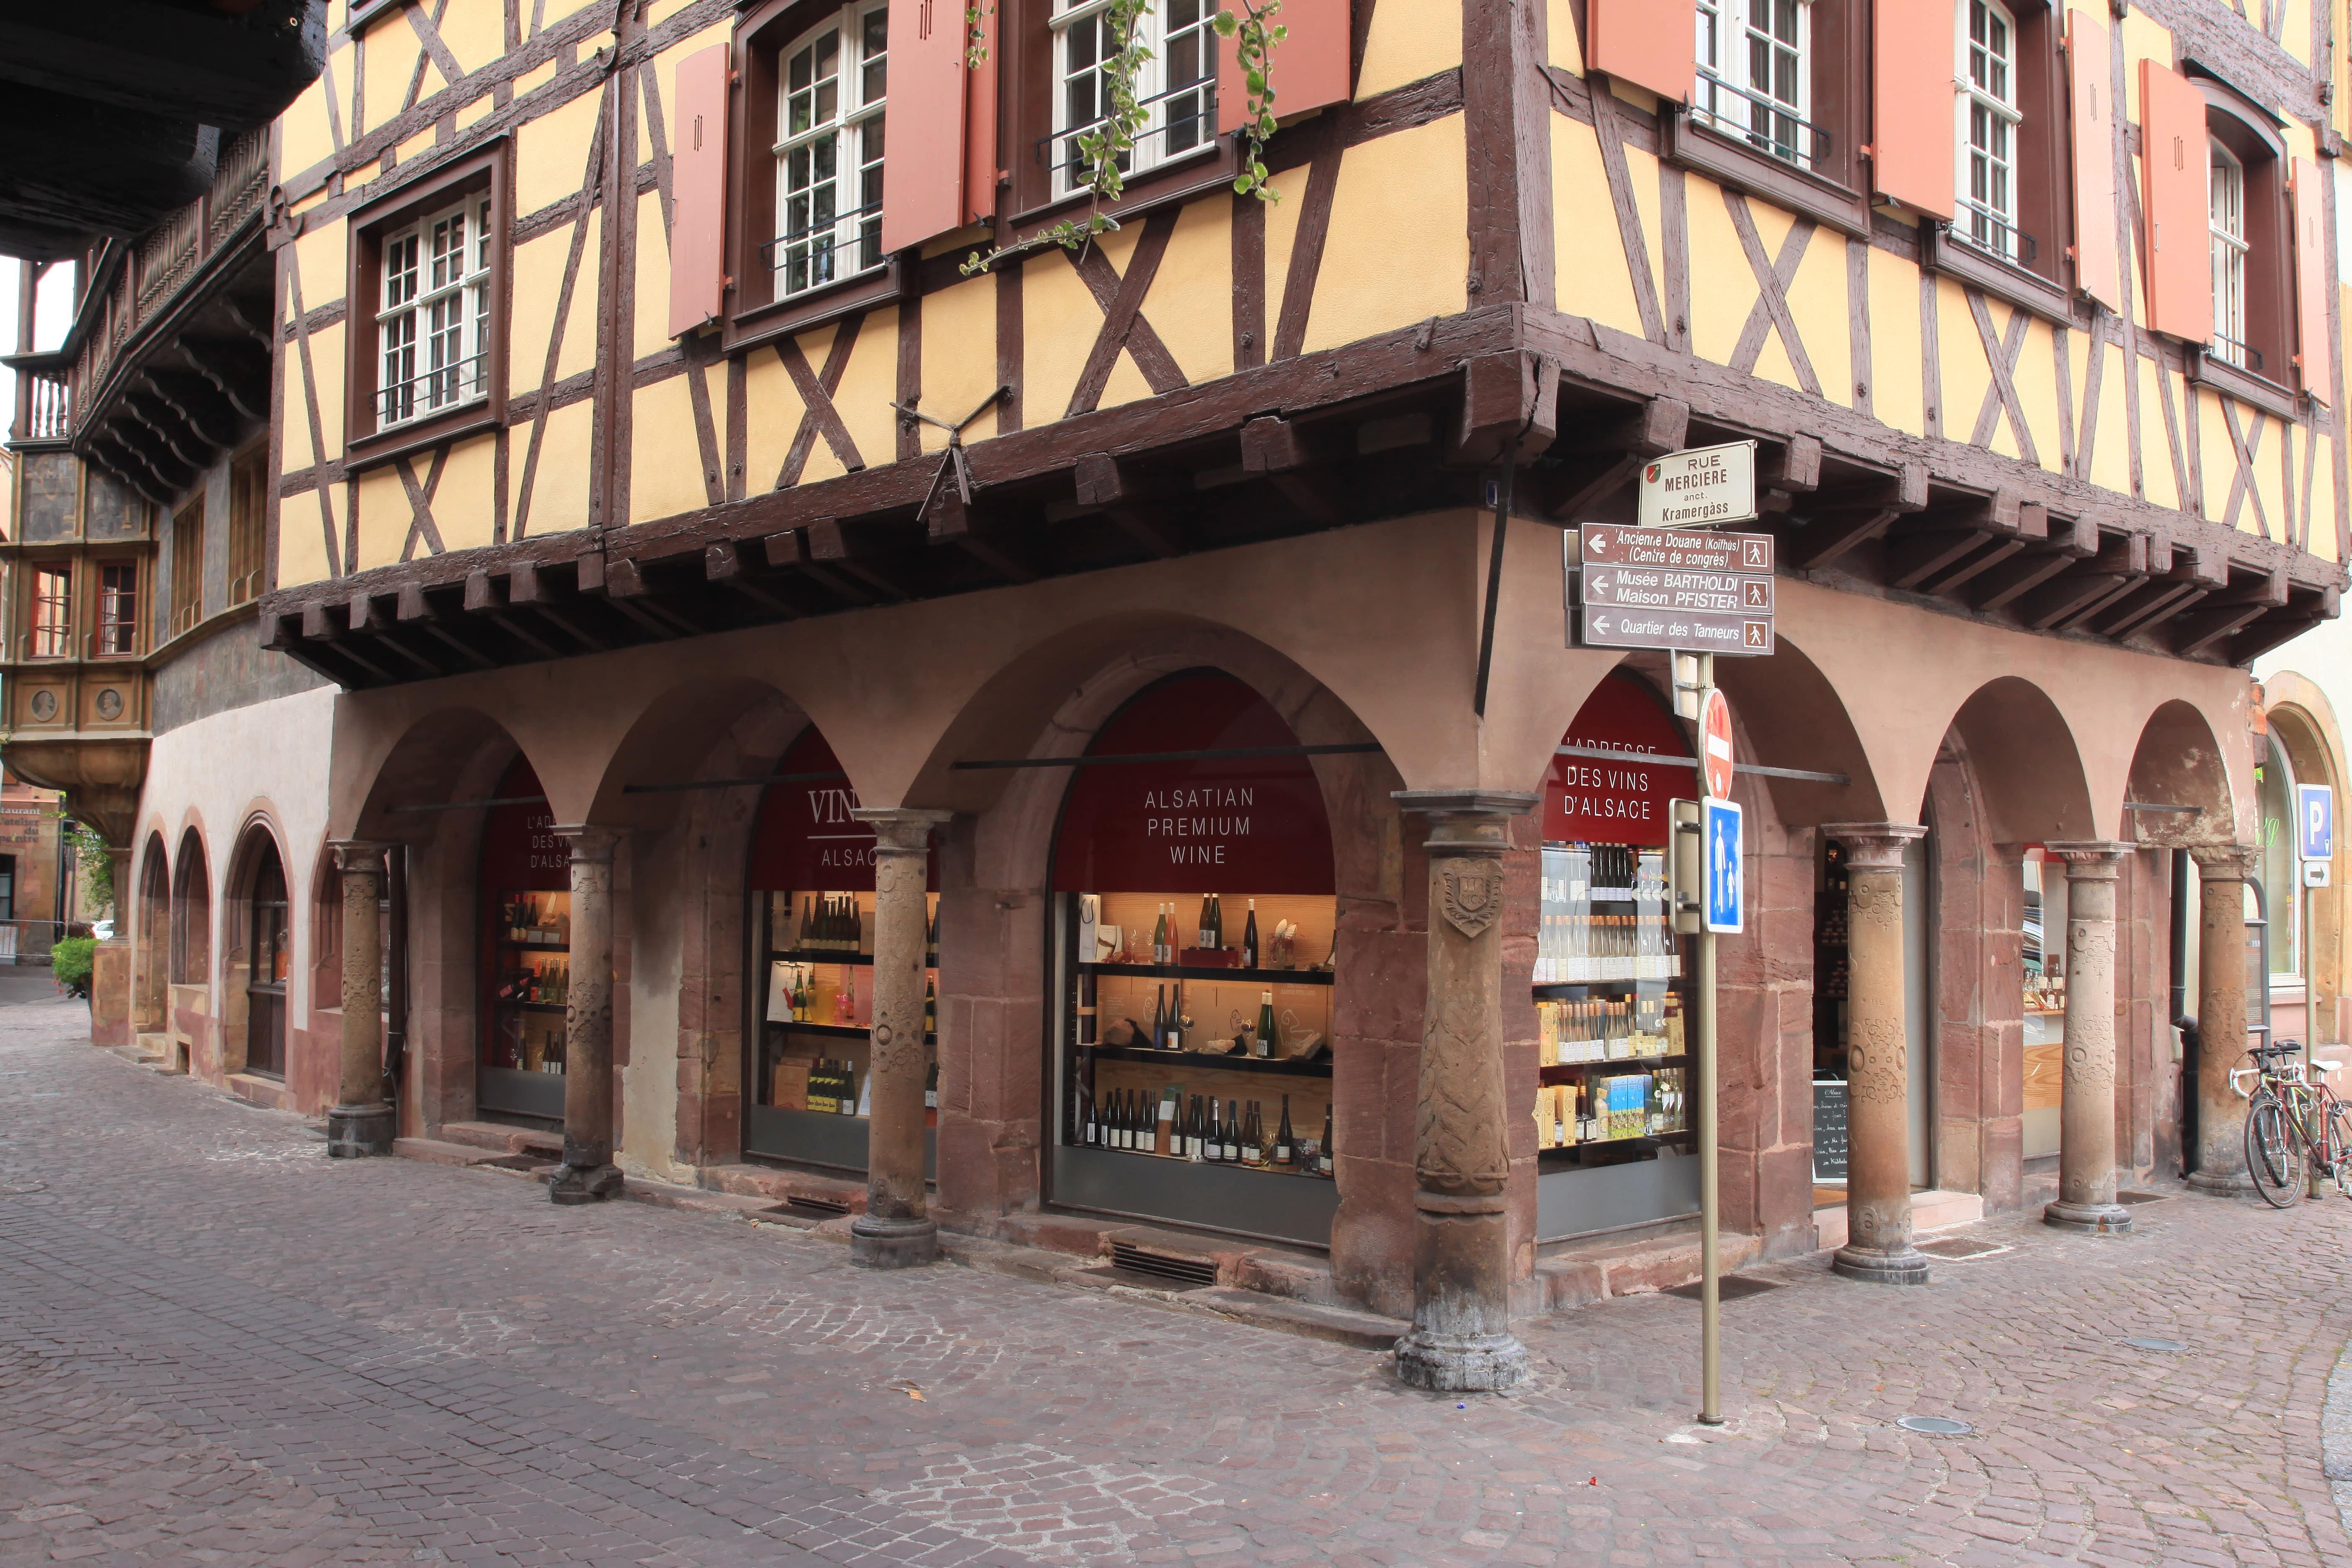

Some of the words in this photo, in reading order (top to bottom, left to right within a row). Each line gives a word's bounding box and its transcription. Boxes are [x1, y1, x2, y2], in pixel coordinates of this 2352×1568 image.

[1688, 454, 1720, 471] RUE
[1665, 469, 1727, 492] MERCIERE
[1684, 492, 1707, 501] anct.
[1662, 502, 1728, 521] Kramergàss
[1617, 530, 1662, 547] Ancienne
[1665, 533, 1701, 549] Douane
[1705, 537, 1740, 552] (Koïfhus)
[1629, 546, 1665, 563] (Centre
[1669, 550, 1681, 564] de
[1686, 552, 1729, 568] congrès)
[1616, 570, 1658, 587] Musée
[1664, 573, 1738, 592] BARTHOLDI
[1616, 588, 1669, 605] Maison
[1675, 592, 1738, 609] PFISTER
[1621, 619, 1664, 635] Quartier
[1669, 622, 1688, 637] des
[1694, 623, 1740, 640] Tanneurs
[1568, 766, 1601, 787] DES
[1608, 770, 1648, 792] VINS
[1145, 788, 1252, 808] ALSATIAN
[1565, 796, 1650, 820] D'ALSACE
[1148, 817, 1249, 836] PREMIUM
[2309, 801, 2324, 845] P
[533, 836, 554, 848] DES
[1170, 846, 1225, 864] WINE
